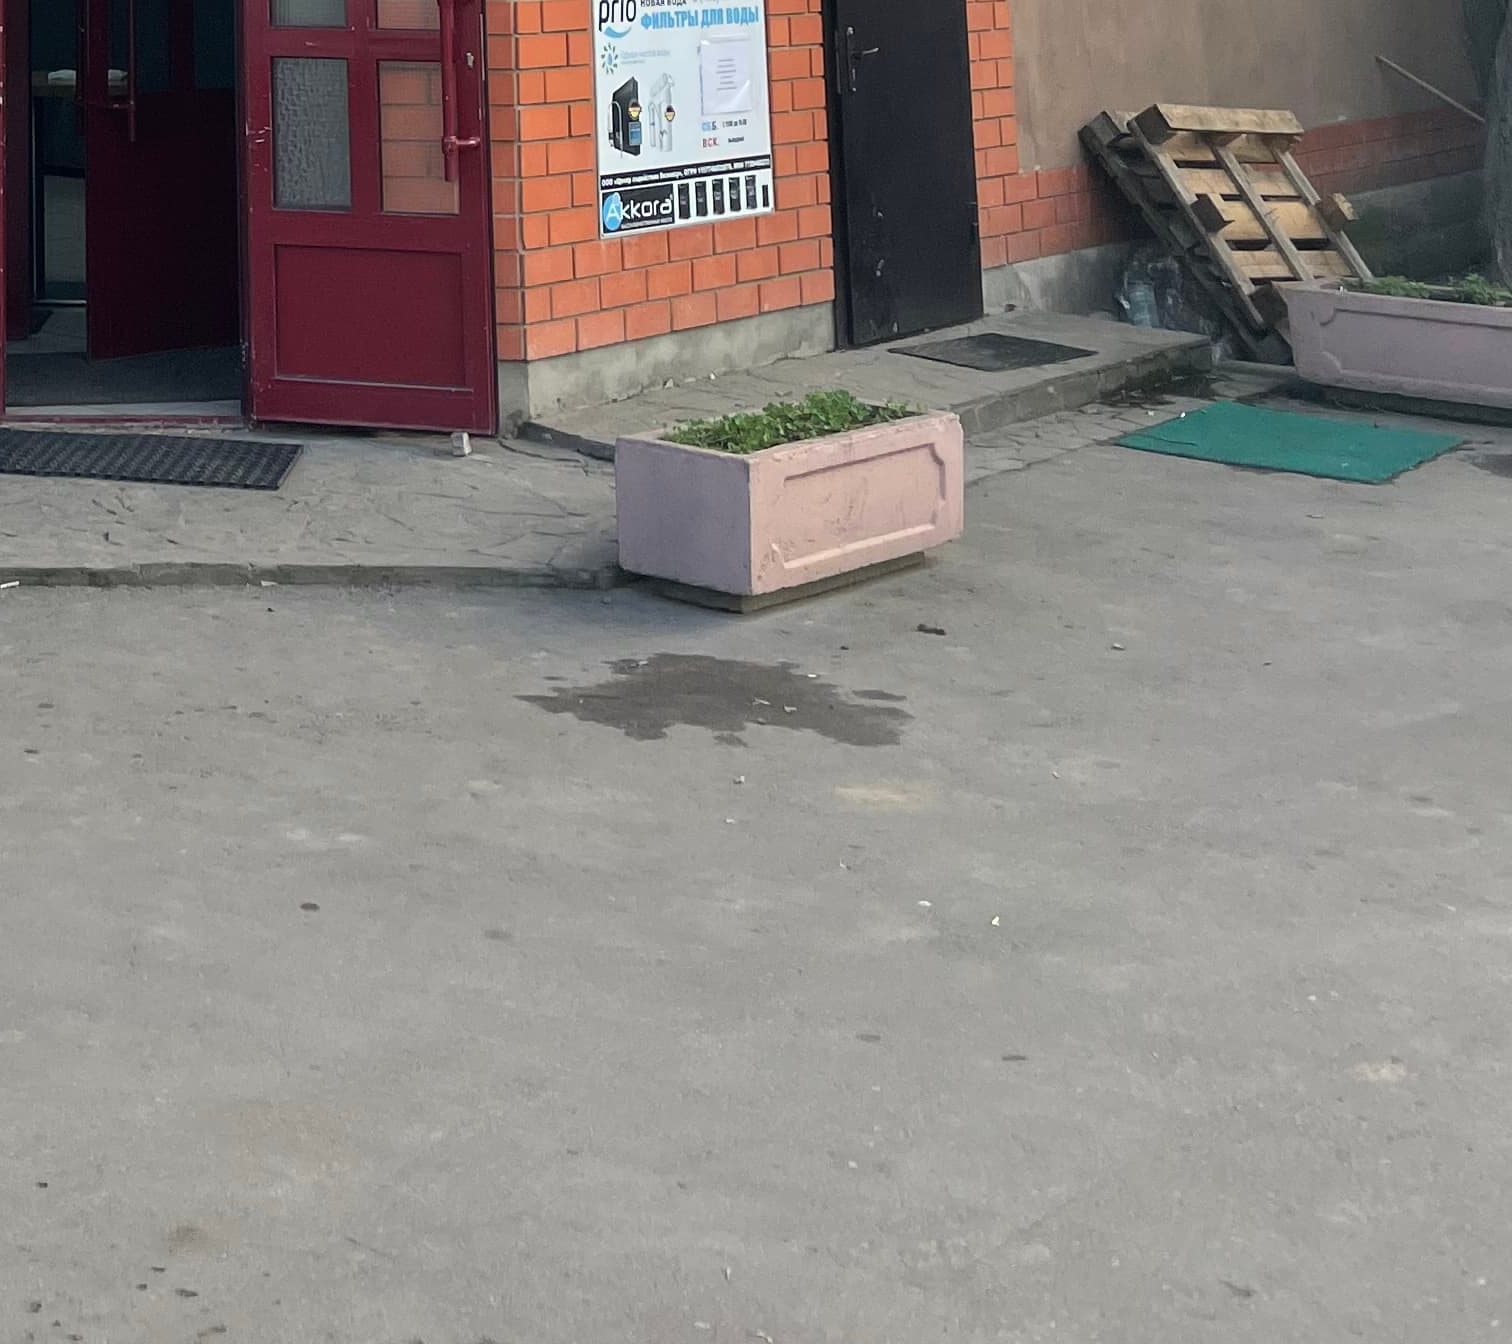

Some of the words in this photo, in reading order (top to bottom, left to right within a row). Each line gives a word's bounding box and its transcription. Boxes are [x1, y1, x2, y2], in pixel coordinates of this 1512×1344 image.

[640, 8, 699, 30] ФИЛЬТРЫ
[701, 8, 724, 28] ДЛЯ
[727, 6, 760, 26] ВОДЫ
[605, 198, 673, 220] Akkora
